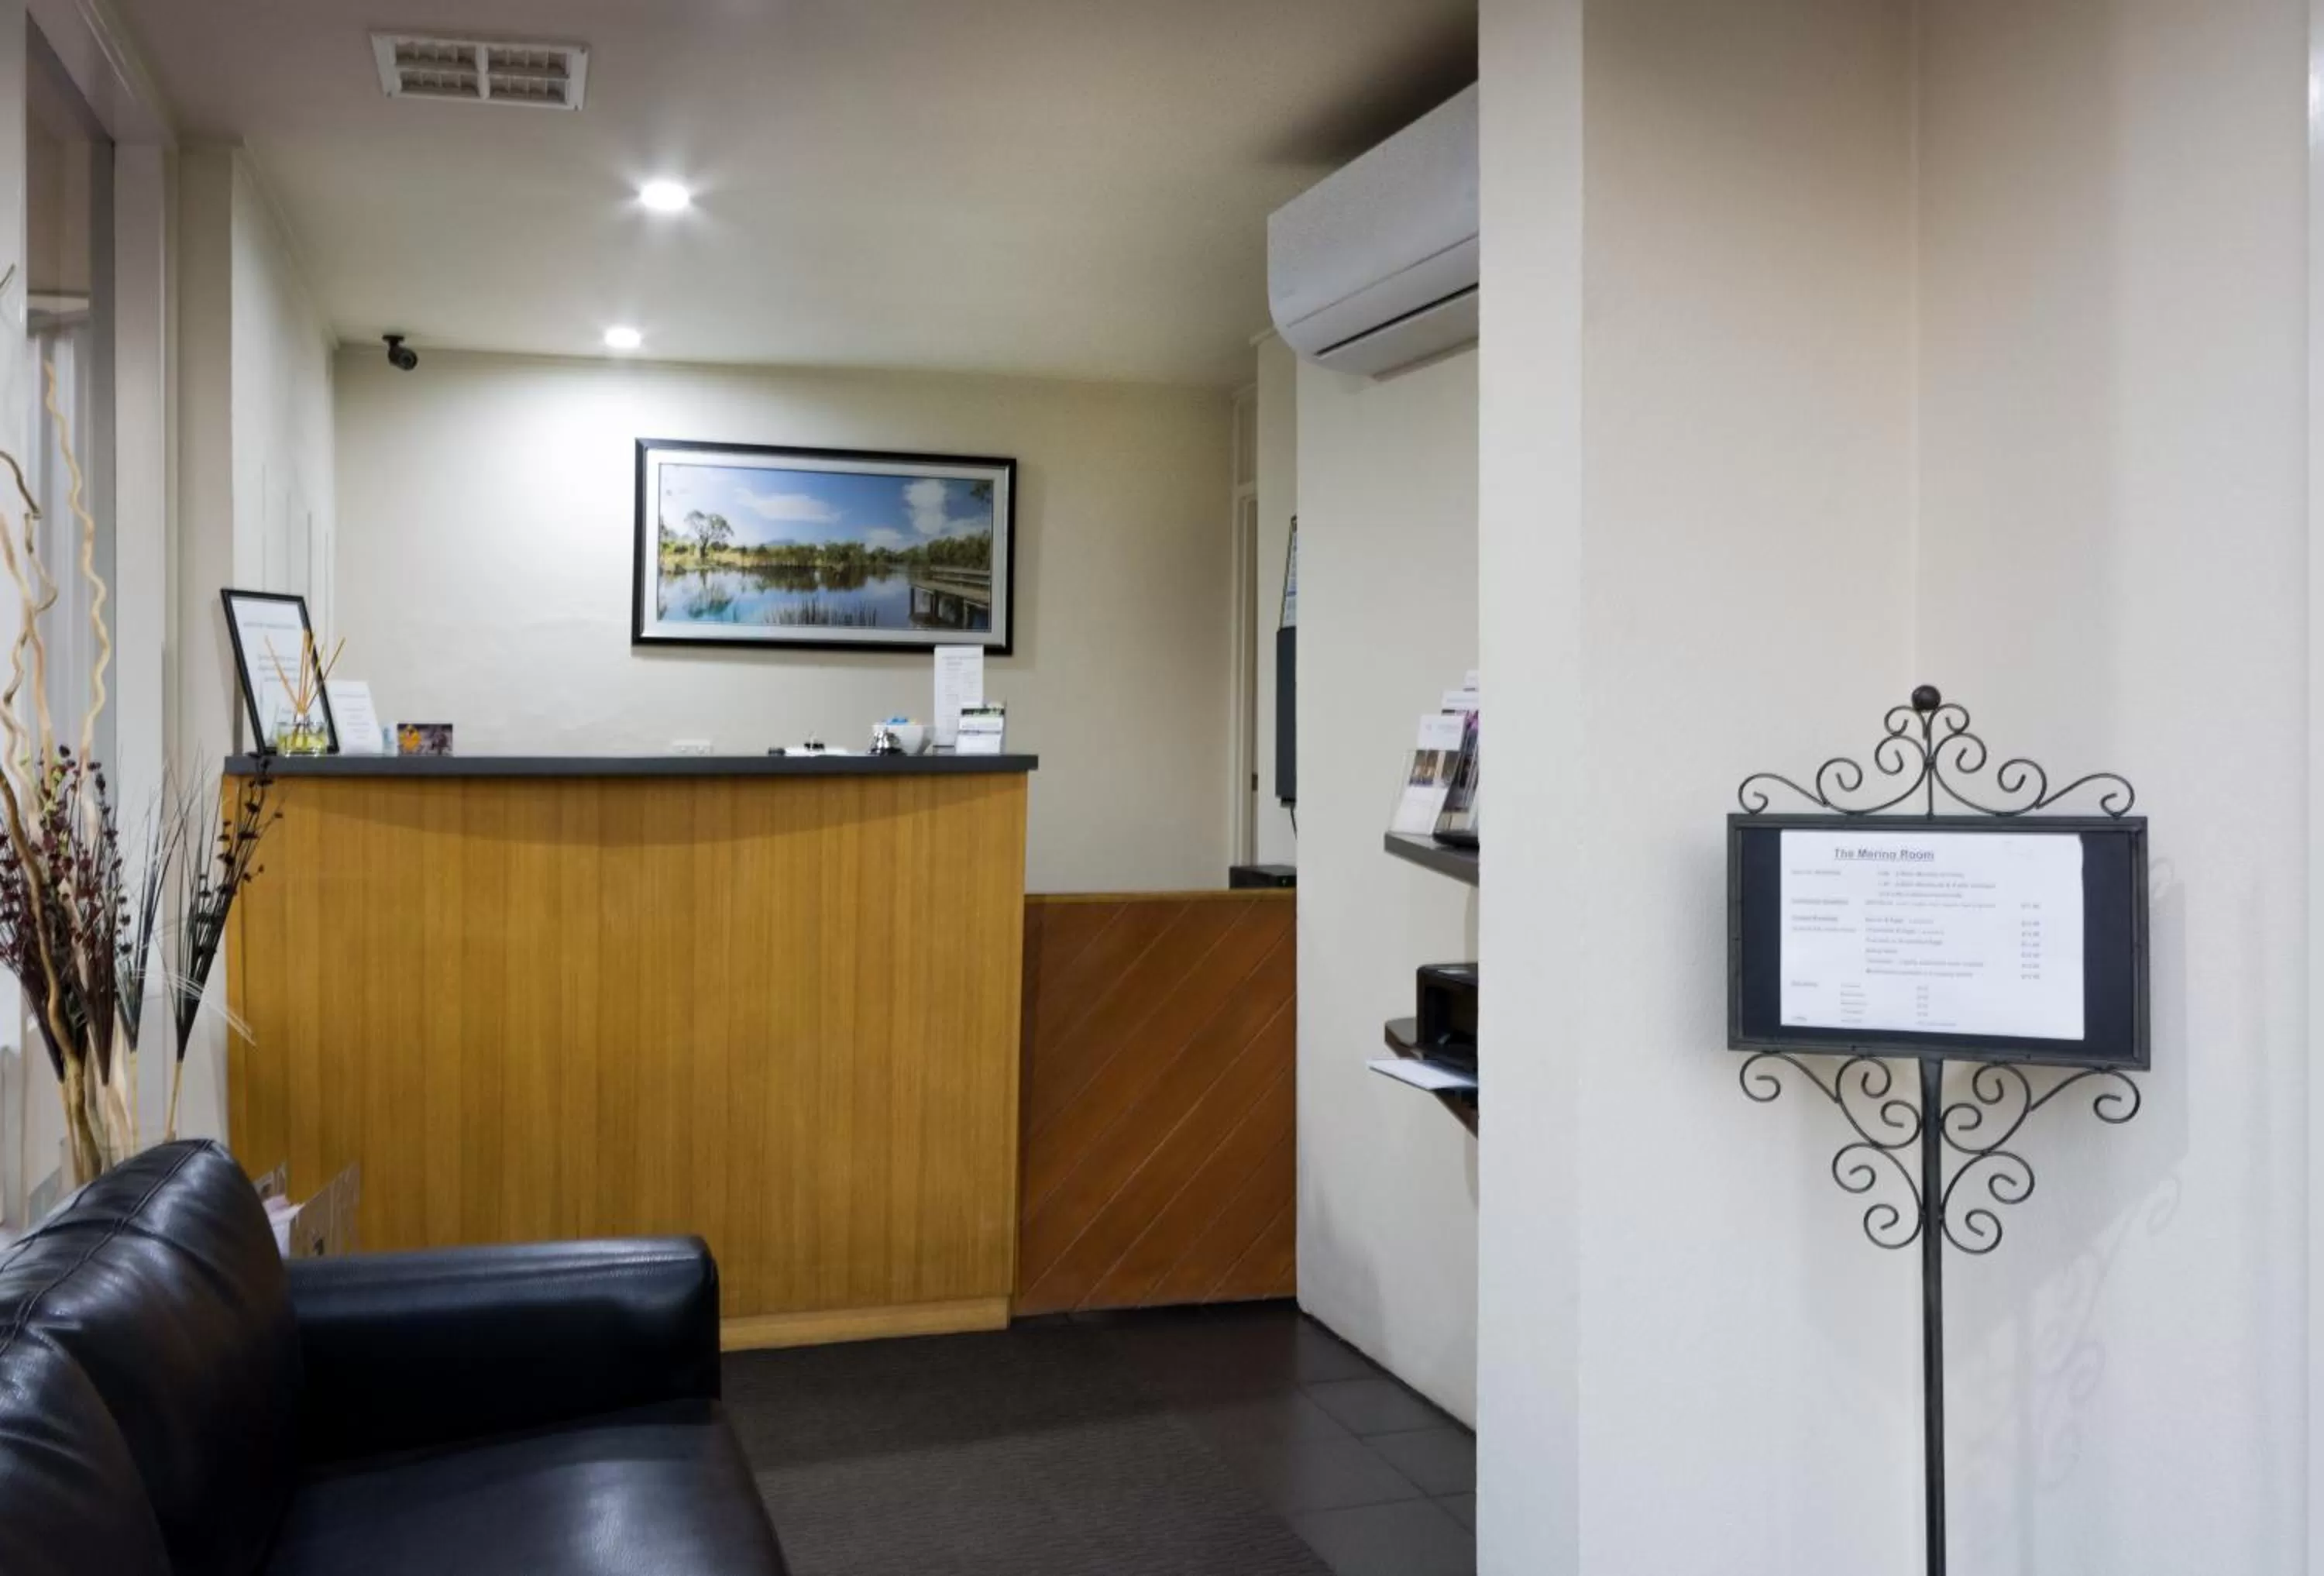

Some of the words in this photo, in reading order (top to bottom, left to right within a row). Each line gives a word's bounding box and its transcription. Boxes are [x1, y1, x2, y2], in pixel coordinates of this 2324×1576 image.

[1834, 848, 1854, 859] The
[1858, 848, 1896, 860] Merino
[1900, 849, 1934, 861] Room
